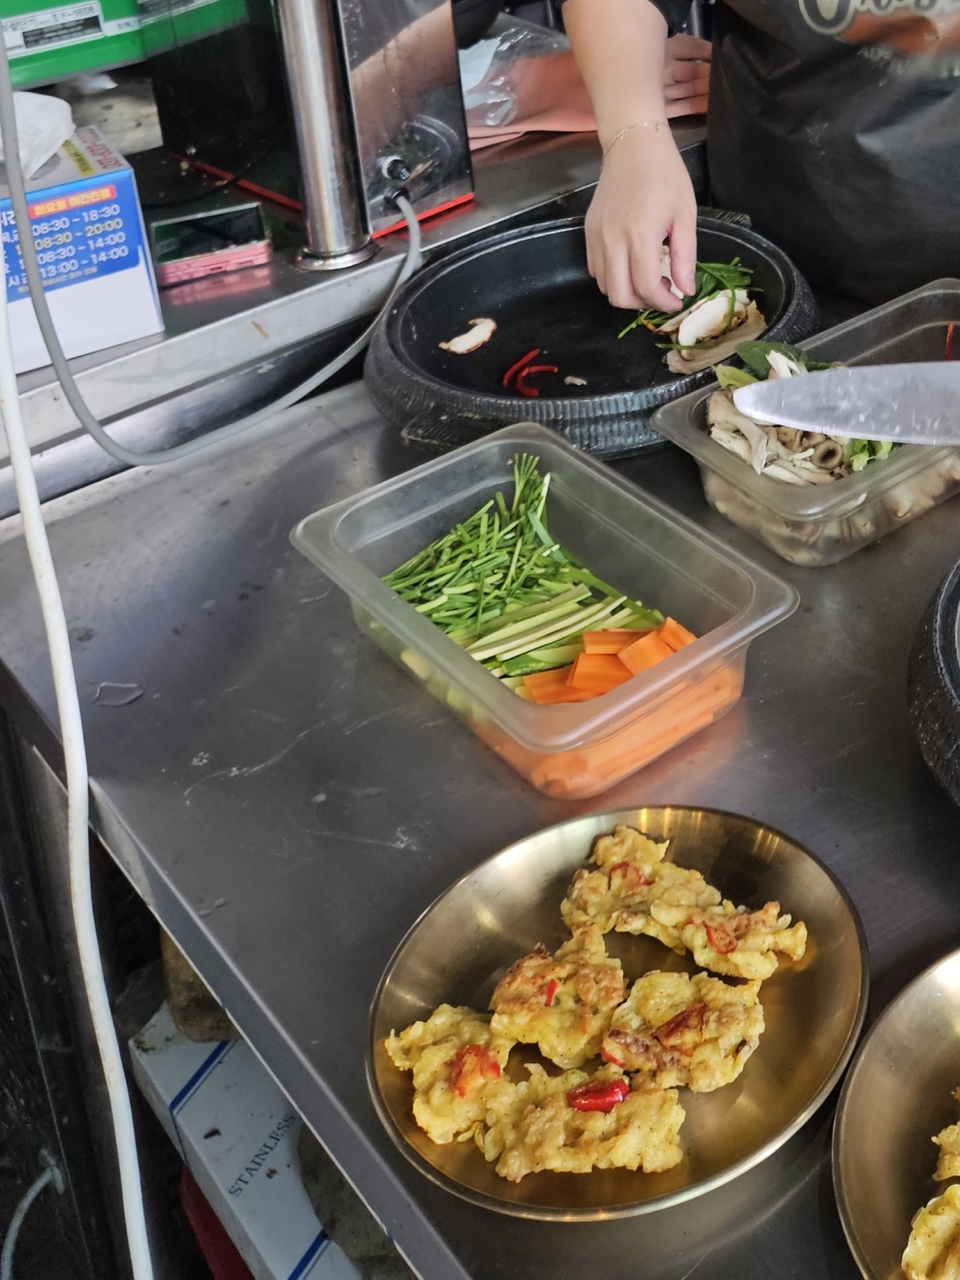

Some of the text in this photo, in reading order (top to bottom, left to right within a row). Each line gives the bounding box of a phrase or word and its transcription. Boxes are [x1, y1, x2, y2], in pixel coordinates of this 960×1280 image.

[32, 218, 70, 236] 08:30
[82, 204, 120, 223] 18:30
[34, 232, 73, 250] 08:30
[85, 218, 123, 237] 20:00
[37, 245, 76, 265] 08:30
[88, 232, 126, 251] 14:00
[40, 259, 79, 279] 13:00
[91, 245, 129, 264] 14:00
[228, 1115, 296, 1197] STAINLESS
